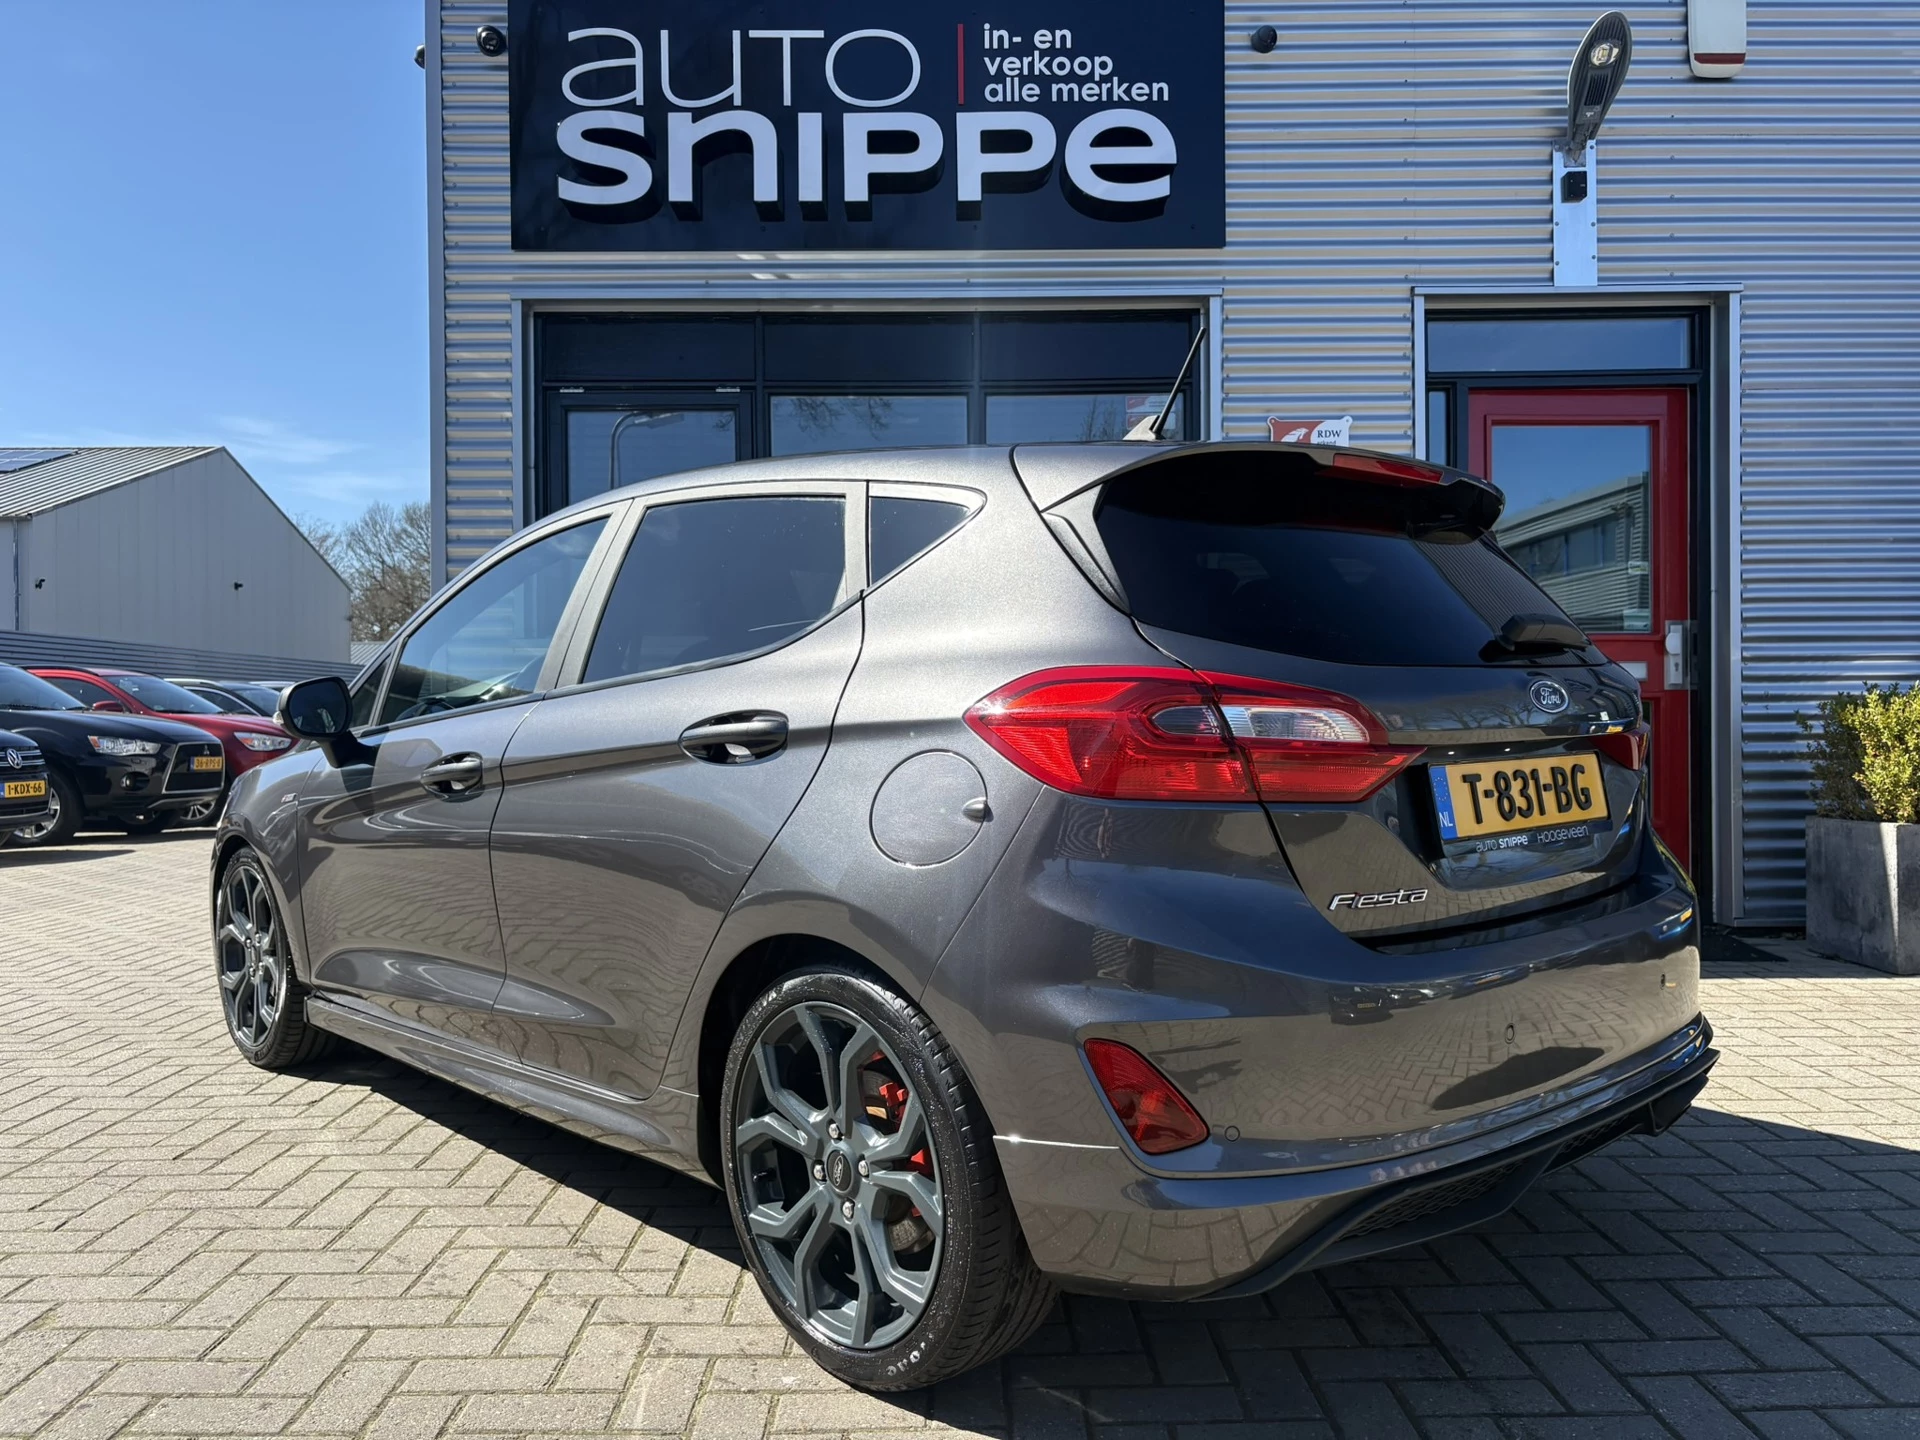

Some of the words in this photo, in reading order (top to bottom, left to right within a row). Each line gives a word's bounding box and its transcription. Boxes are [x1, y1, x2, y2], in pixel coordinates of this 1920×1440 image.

[983, 24, 1022, 51] in-
[1032, 27, 1072, 51] en
[983, 51, 1113, 82] verkoop
[984, 78, 1041, 104] alle
[1050, 78, 1170, 103] merken
[1317, 429, 1342, 438] RDW
[7, 782, 42, 796] 1-KDX-66
[1462, 763, 1593, 825] T-831-BG
[1439, 811, 1453, 828] NL
